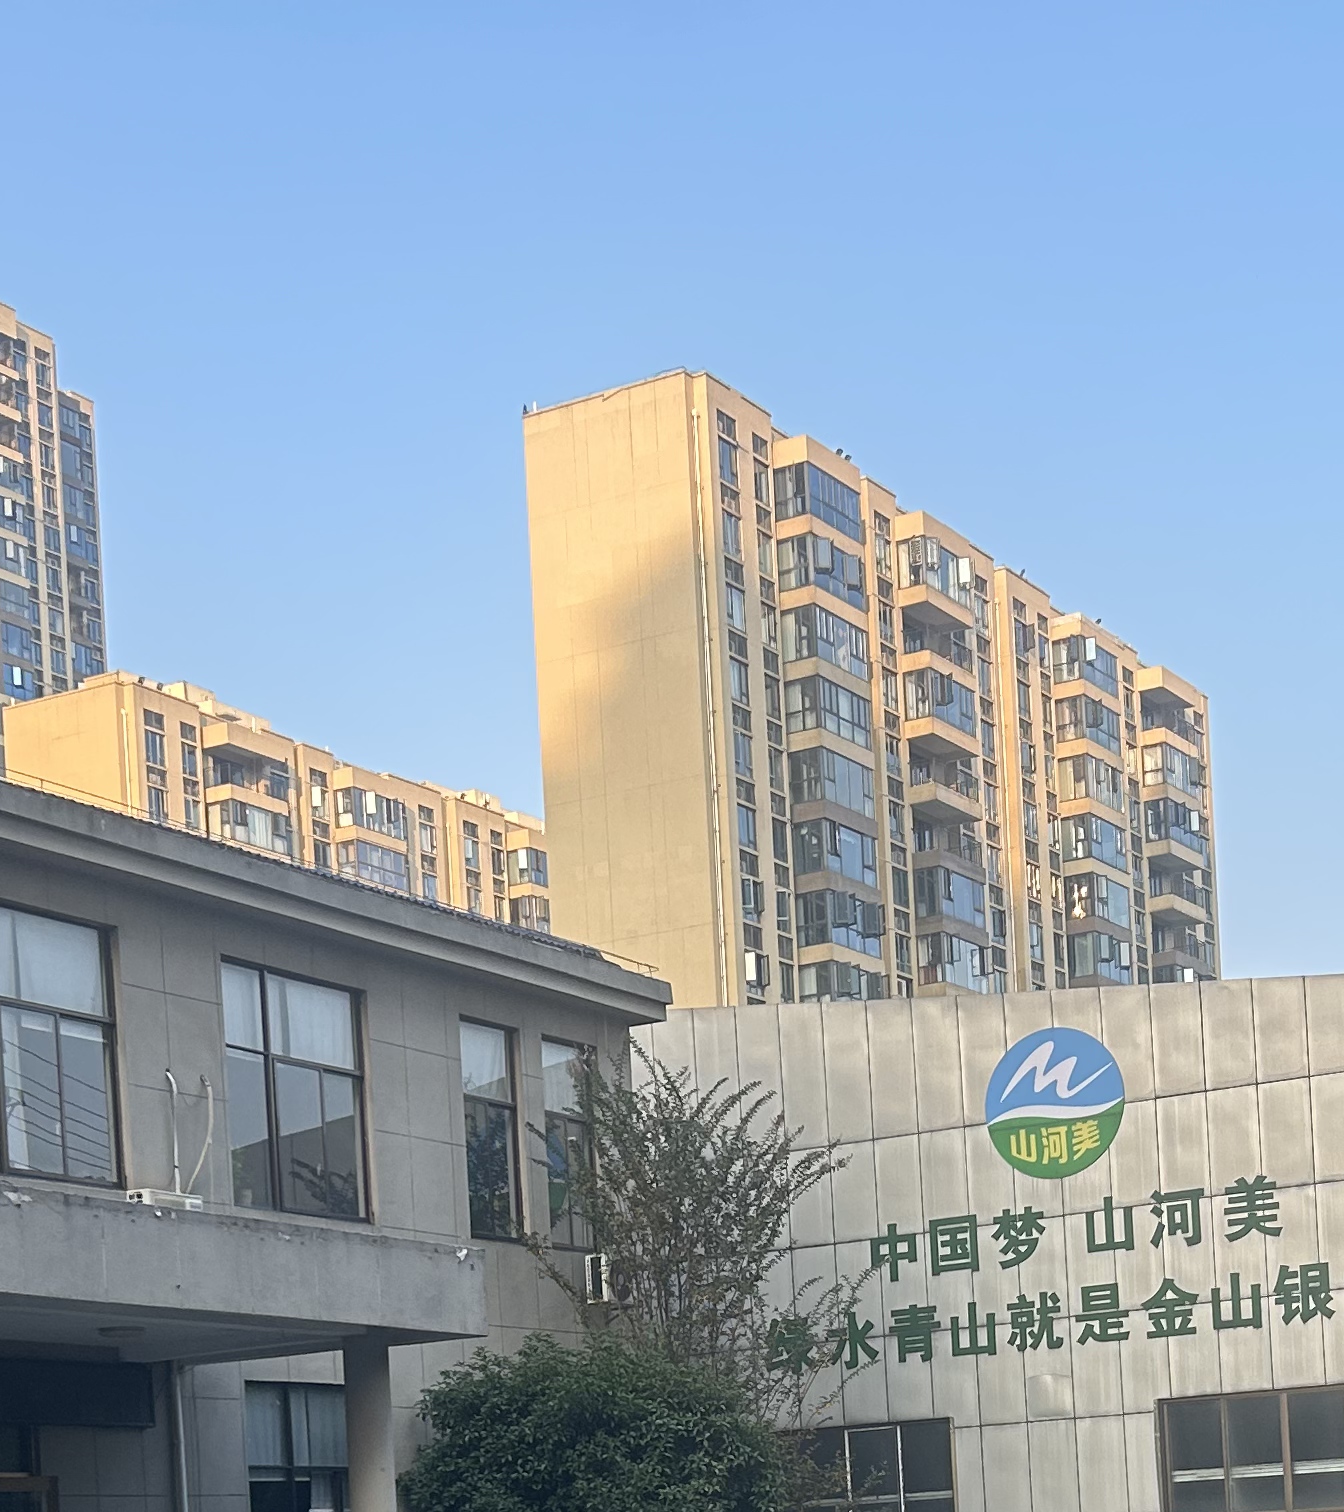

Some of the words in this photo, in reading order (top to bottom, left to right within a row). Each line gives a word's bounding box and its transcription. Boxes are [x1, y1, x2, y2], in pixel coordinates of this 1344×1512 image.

[1009, 1118, 1101, 1165] 山河美
[868, 1206, 1046, 1283] 中国梦
[1085, 1174, 1284, 1254] 山河美
